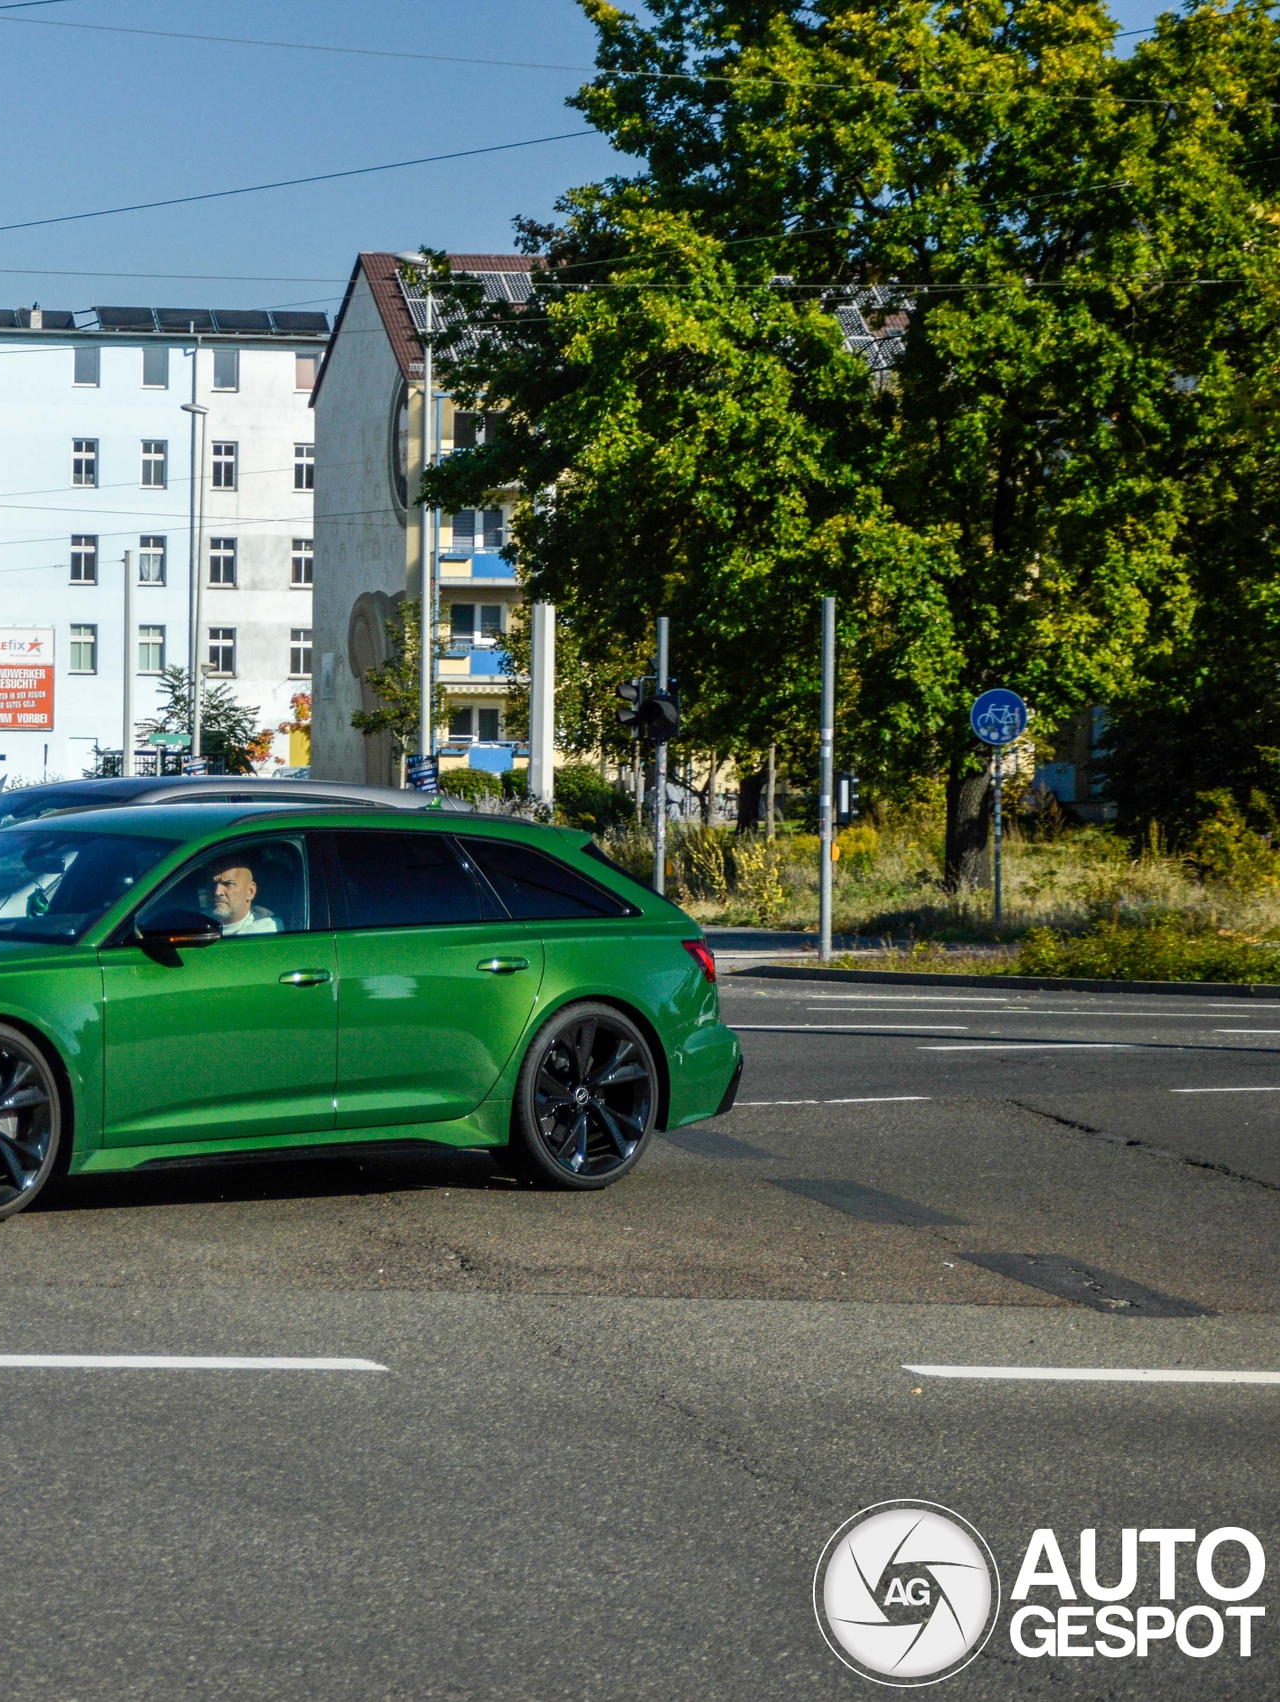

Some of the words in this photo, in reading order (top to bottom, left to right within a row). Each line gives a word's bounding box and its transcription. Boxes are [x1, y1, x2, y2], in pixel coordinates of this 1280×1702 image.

[10, 692, 16, 700] IN
[17, 691, 26, 699] DER
[28, 690, 46, 698] REGION
[6, 700, 21, 709] GUTES
[17, 713, 48, 723] VORBEI
